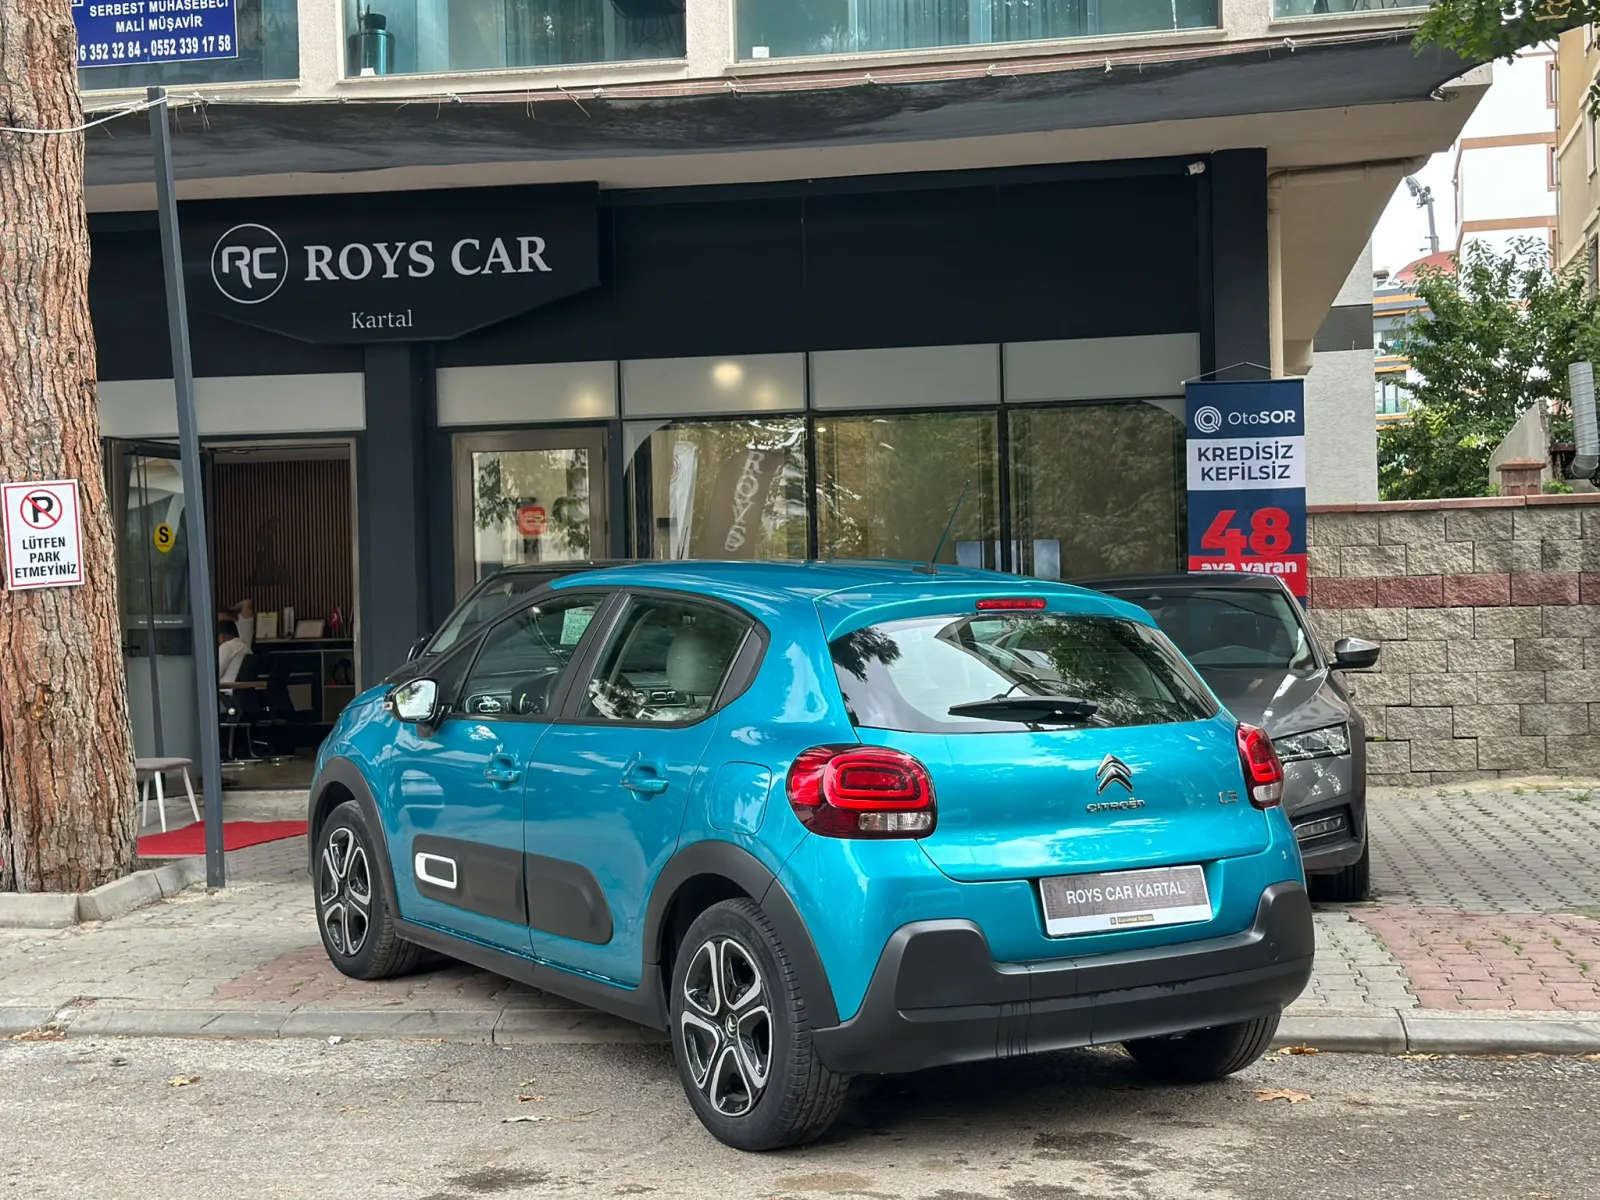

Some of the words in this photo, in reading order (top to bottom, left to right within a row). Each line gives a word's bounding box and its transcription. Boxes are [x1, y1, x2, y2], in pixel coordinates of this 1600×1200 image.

[89, 2, 145, 17] SERBEST
[116, 17, 145, 33] MALİ
[148, 14, 203, 32] MÜŞAVİR
[89, 43, 109, 60] 352
[112, 42, 125, 59] 32
[127, 41, 141, 58] 84
[150, 39, 177, 56] 0552
[179, 36, 199, 55] 339
[202, 36, 215, 53] 17
[218, 34, 231, 52] 58
[221, 245, 277, 289] RC
[303, 240, 435, 281] ROYS
[451, 236, 552, 276] CAR
[351, 309, 413, 329] Kartal
[1228, 409, 1296, 425] OtoSOR
[1197, 440, 1294, 462] KREDİSİZ
[1201, 461, 1291, 481] KEFİLSİZ
[159, 526, 169, 543] S
[1201, 507, 1292, 557] 48
[22, 536, 66, 550] LÜTFEN
[29, 551, 61, 564] PARK
[14, 563, 78, 579] ETMEYİNİZ
[1240, 561, 1298, 574] varan
[1066, 888, 1102, 905] ROYS
[1105, 885, 1133, 901] CAR
[1135, 881, 1186, 899] KARTAL
